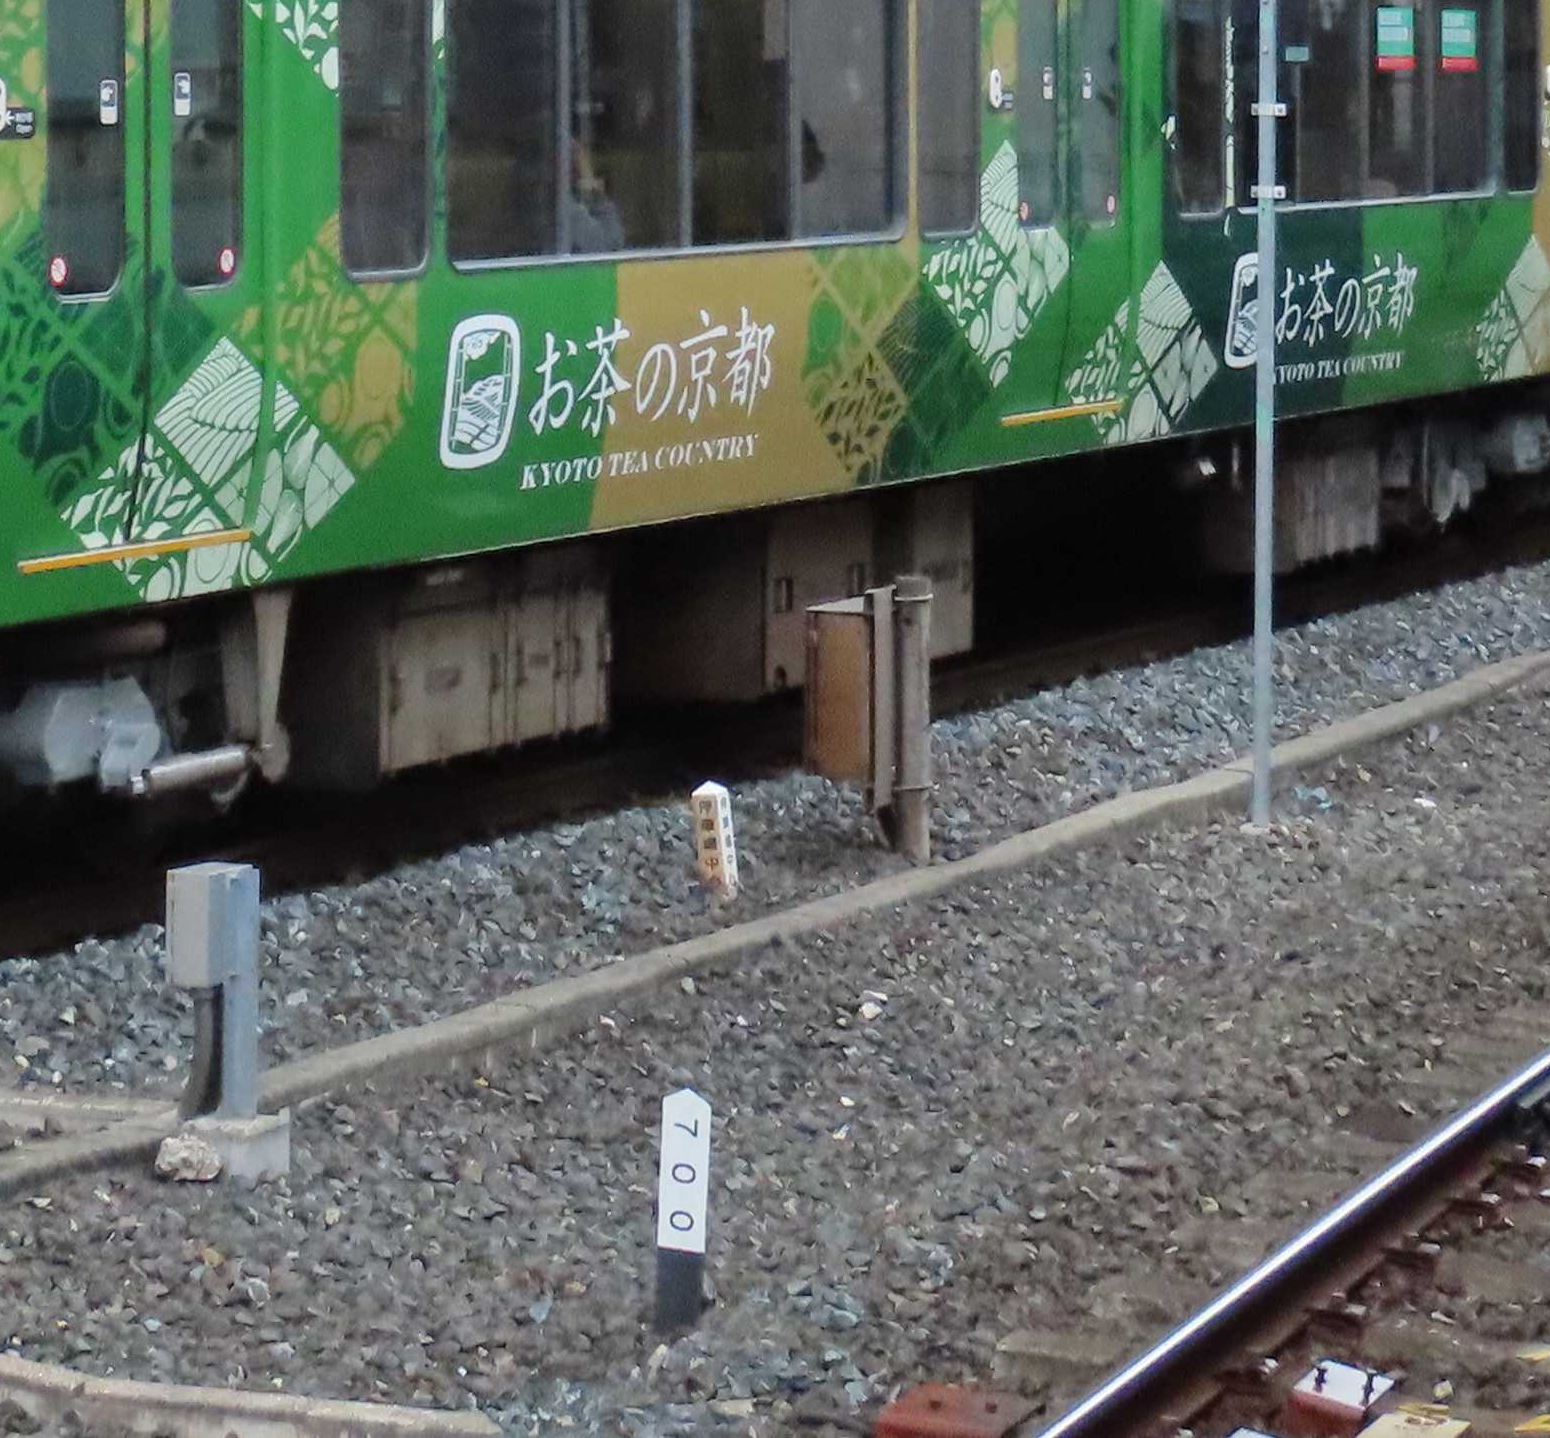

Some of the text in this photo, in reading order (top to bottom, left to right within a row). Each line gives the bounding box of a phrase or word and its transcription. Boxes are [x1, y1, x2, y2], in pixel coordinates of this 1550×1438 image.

[1274, 252, 1419, 347] お茶の京都
[528, 305, 776, 439] お茶の京都
[1274, 364, 1315, 385] YOTO
[518, 432, 759, 491] KYOTO TEA COUNTRY
[669, 1118, 699, 1232] 700
